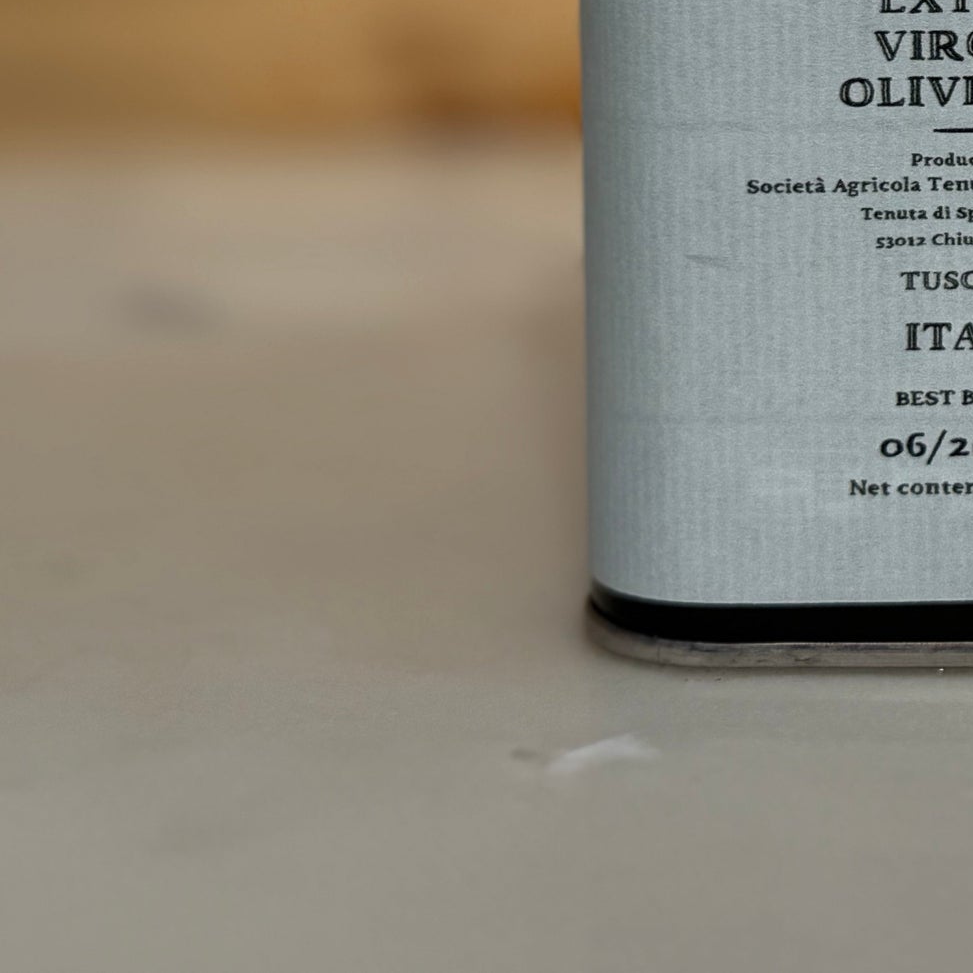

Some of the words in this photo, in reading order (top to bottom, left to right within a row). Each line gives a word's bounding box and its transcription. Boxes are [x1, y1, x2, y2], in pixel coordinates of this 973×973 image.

[746, 177, 826, 195] Società
[832, 176, 921, 198] Agricola
[860, 207, 928, 221] Tenuta
[933, 205, 951, 220] di
[876, 236, 926, 249] 53012
[896, 390, 956, 407] BEST
[850, 479, 890, 497] Net
